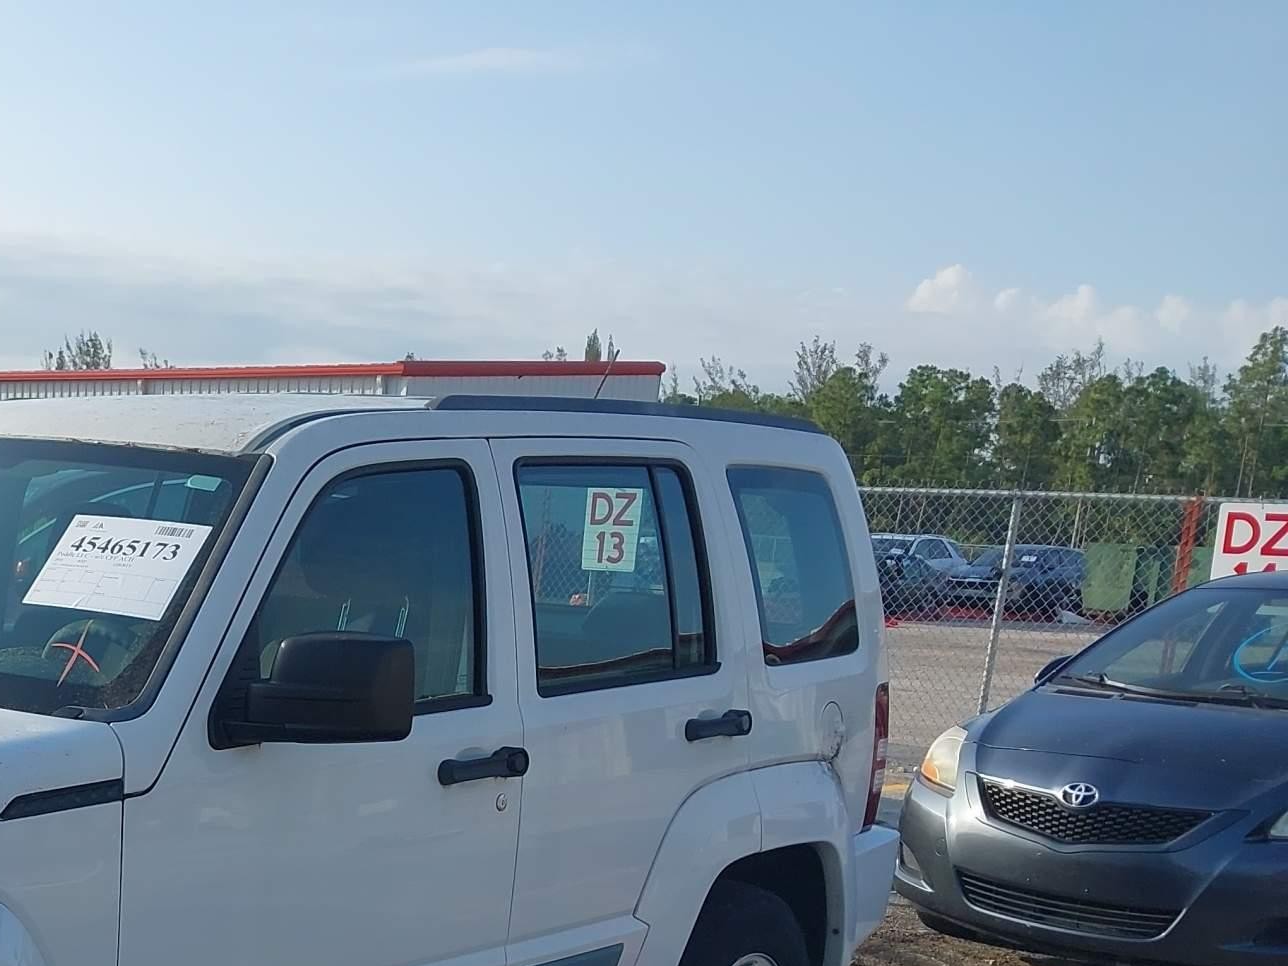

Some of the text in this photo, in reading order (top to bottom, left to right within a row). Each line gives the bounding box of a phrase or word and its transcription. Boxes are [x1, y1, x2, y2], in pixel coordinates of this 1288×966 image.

[589, 491, 638, 527] DZ
[70, 535, 181, 561] 45465173
[596, 531, 625, 565] 13
[1222, 511, 1288, 557] DZ
